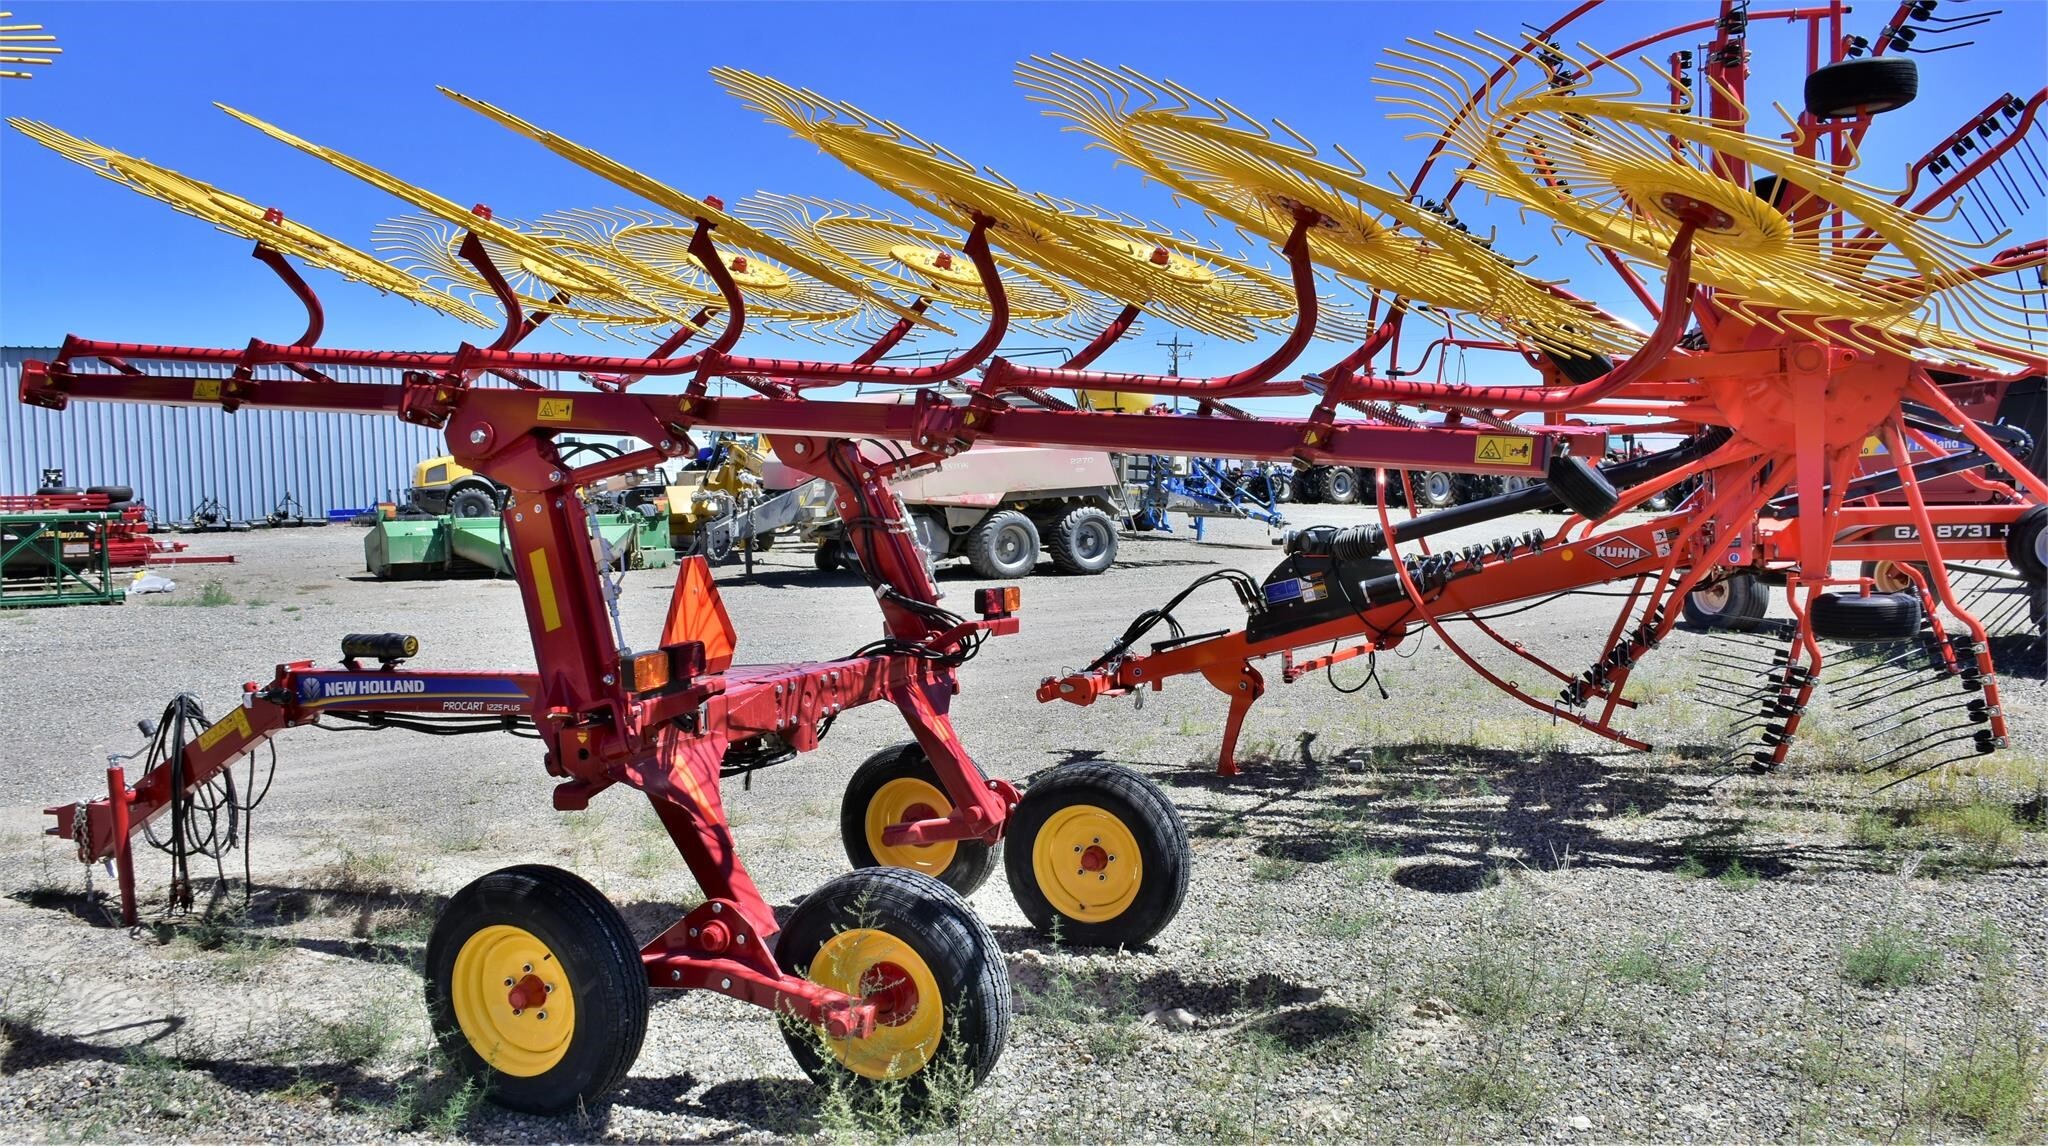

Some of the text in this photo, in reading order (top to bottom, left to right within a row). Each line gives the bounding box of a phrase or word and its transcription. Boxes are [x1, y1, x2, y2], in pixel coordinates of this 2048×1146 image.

[1936, 524, 1992, 538] 8731
[1595, 546, 1640, 559] KUHN
[324, 680, 425, 697] NEW HOLLAND
[442, 701, 520, 712] PROCART 1225 PLUS
